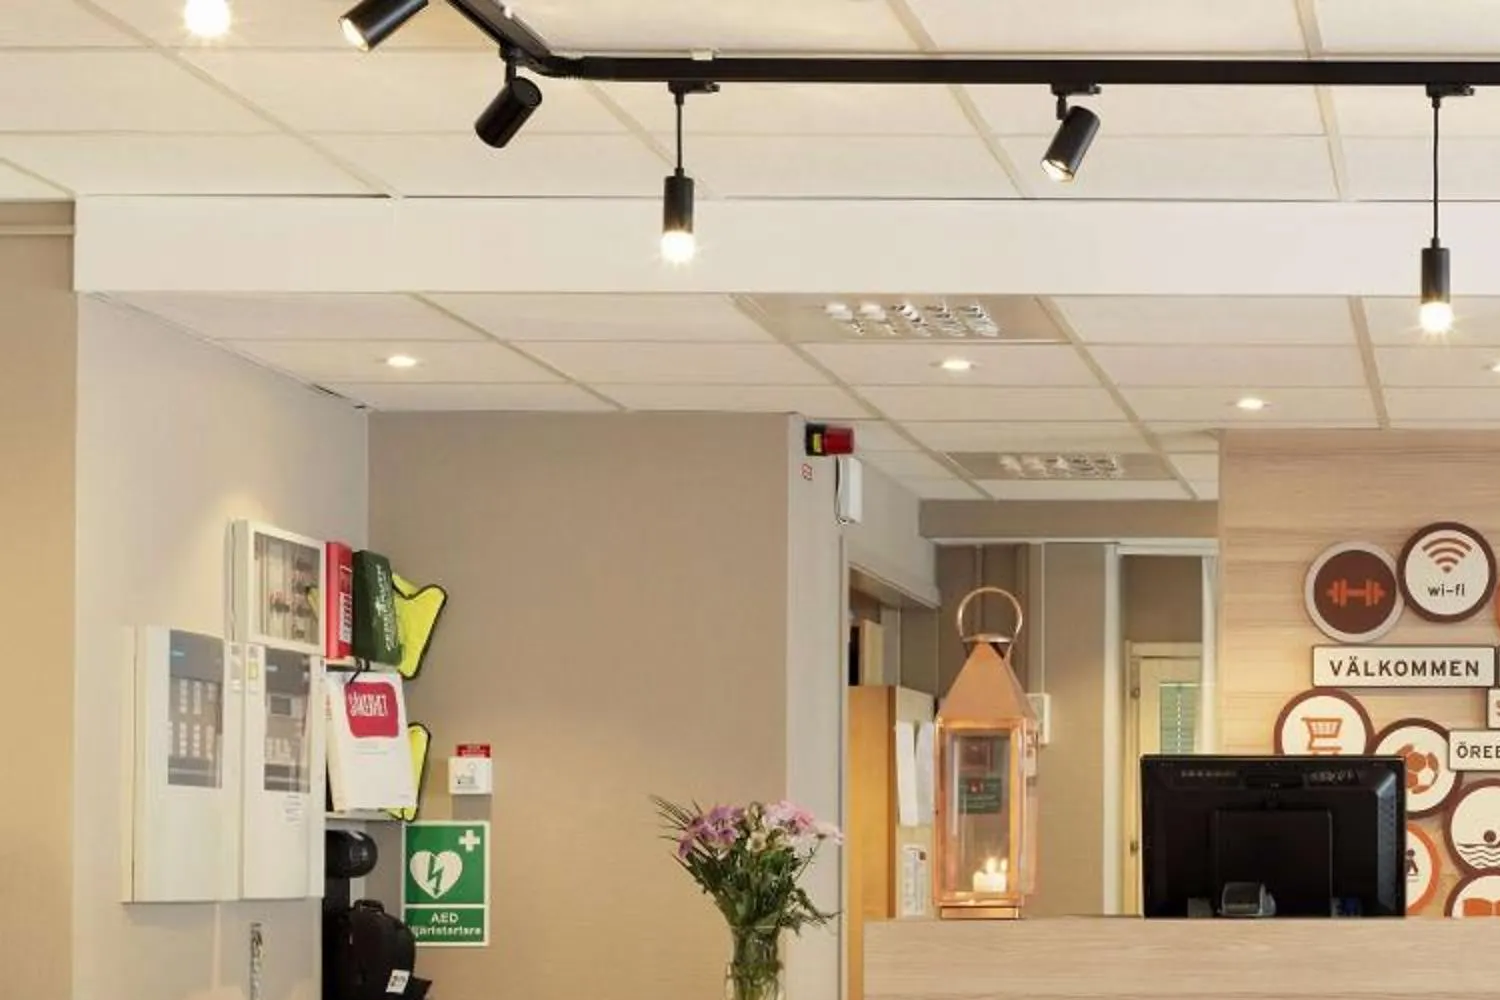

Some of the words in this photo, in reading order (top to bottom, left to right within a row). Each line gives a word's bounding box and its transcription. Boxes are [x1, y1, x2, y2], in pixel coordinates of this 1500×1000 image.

[1427, 583, 1466, 597] wi-fi
[1330, 656, 1479, 677] VÄLKOMMEN
[431, 911, 459, 924] AED
